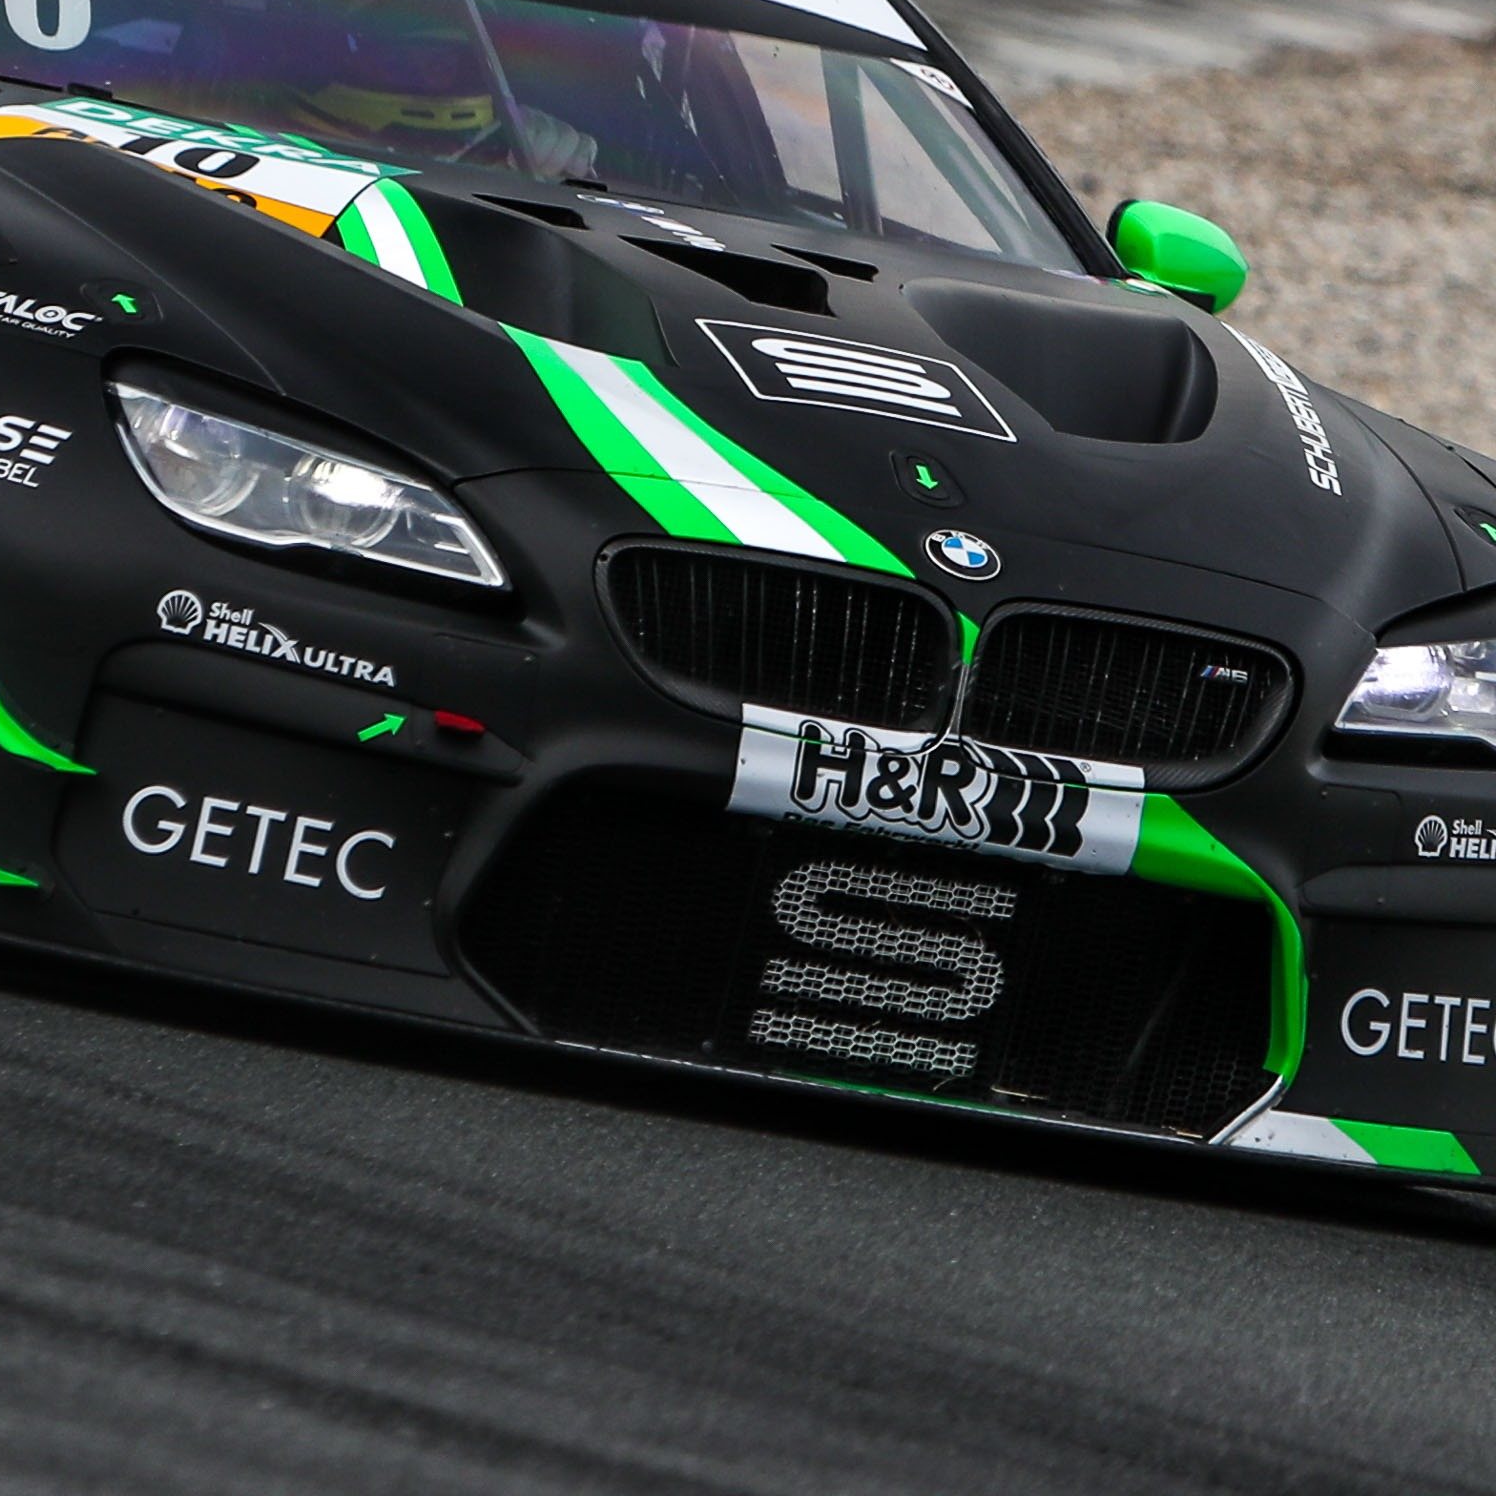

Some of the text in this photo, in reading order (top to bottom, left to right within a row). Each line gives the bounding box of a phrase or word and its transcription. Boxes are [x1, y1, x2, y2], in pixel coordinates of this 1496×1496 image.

[54, 101, 383, 176] DEKRA
[21, 320, 75, 339] QUALITY
[208, 600, 255, 626] Shell
[203, 618, 396, 688] HELIX ULTRA
[122, 785, 395, 900] GETEC
[1451, 819, 1483, 836] Shell
